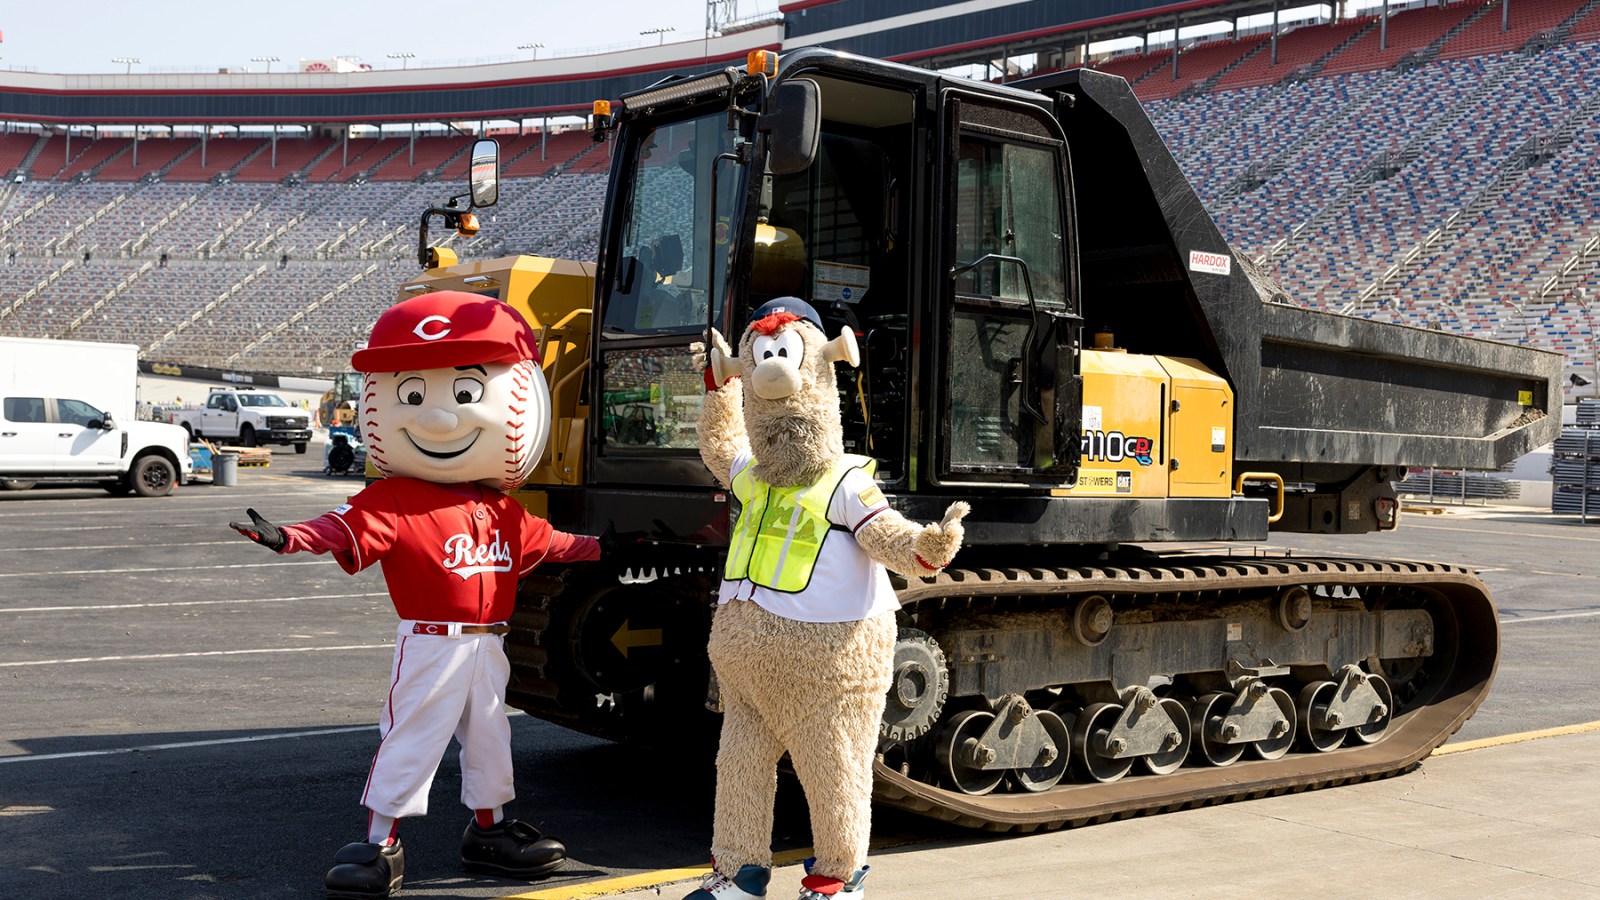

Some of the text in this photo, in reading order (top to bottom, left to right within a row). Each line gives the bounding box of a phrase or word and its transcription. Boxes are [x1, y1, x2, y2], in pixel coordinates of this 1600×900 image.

[1191, 253, 1227, 268] HARDOX
[412, 314, 452, 341] C
[1117, 475, 1131, 488] CAT
[442, 529, 512, 571] Reds
